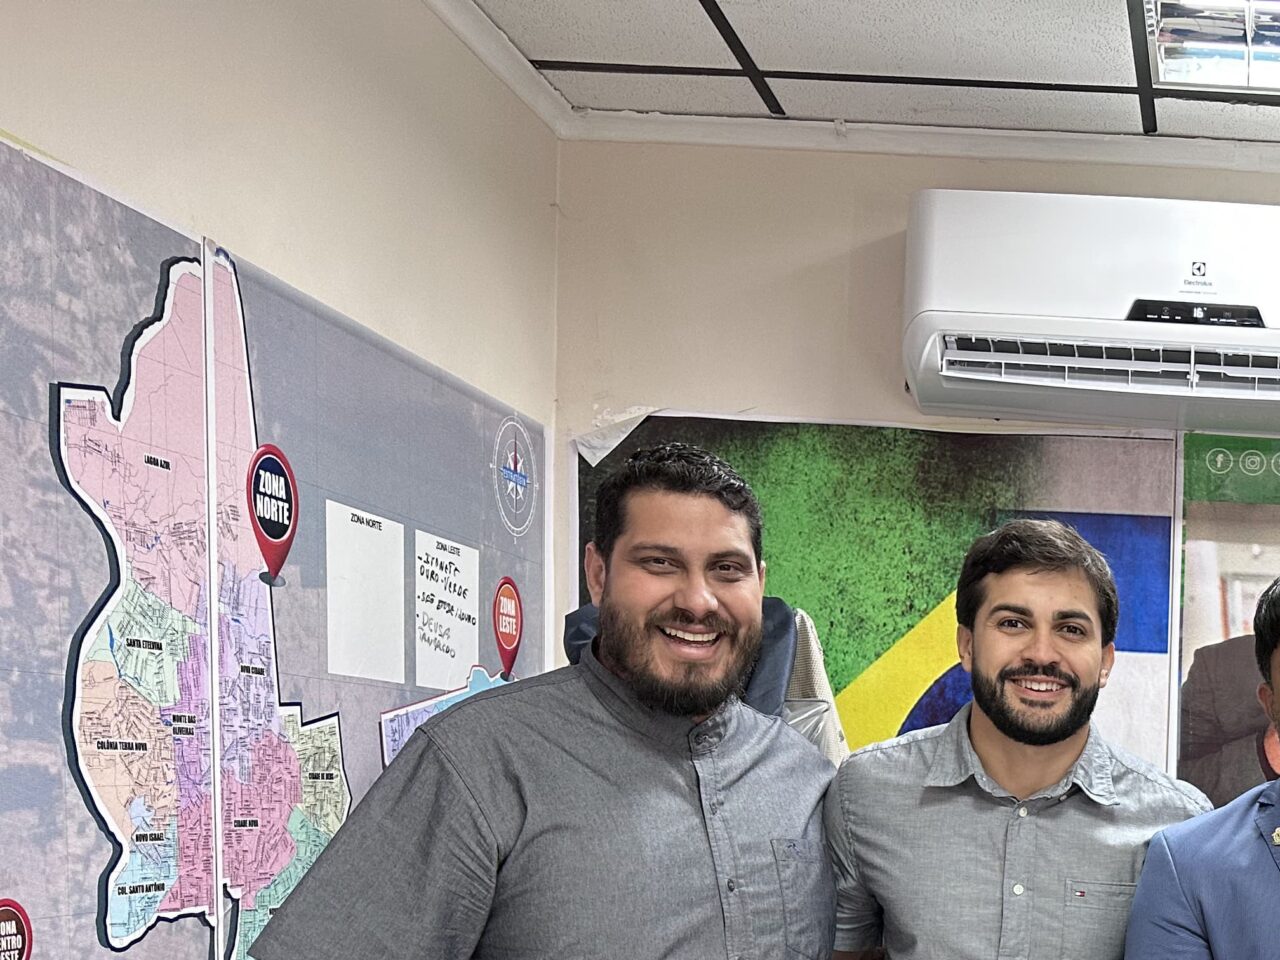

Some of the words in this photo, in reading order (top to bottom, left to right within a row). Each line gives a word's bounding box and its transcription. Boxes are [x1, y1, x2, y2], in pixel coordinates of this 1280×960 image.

[258, 470, 286, 500] ZONA
[256, 494, 290, 526] NORTE
[350, 513, 365, 525] ZONA
[365, 518, 383, 532] NORTE
[435, 541, 448, 552] ZONA
[448, 543, 461, 557] LESTE
[500, 596, 515, 615] ZONA
[499, 615, 516, 636] LESTE
[126, 638, 143, 650] SANTA
[97, 739, 116, 751] COLÔNIA
[132, 742, 148, 752] NOVA
[135, 833, 148, 842] NOVO
[117, 886, 128, 896] COL.
[128, 884, 144, 895] SANTO
[145, 882, 165, 893] ANTÔNIO
[0, 920, 17, 936] ONA
[0, 934, 22, 951] ENTRO
